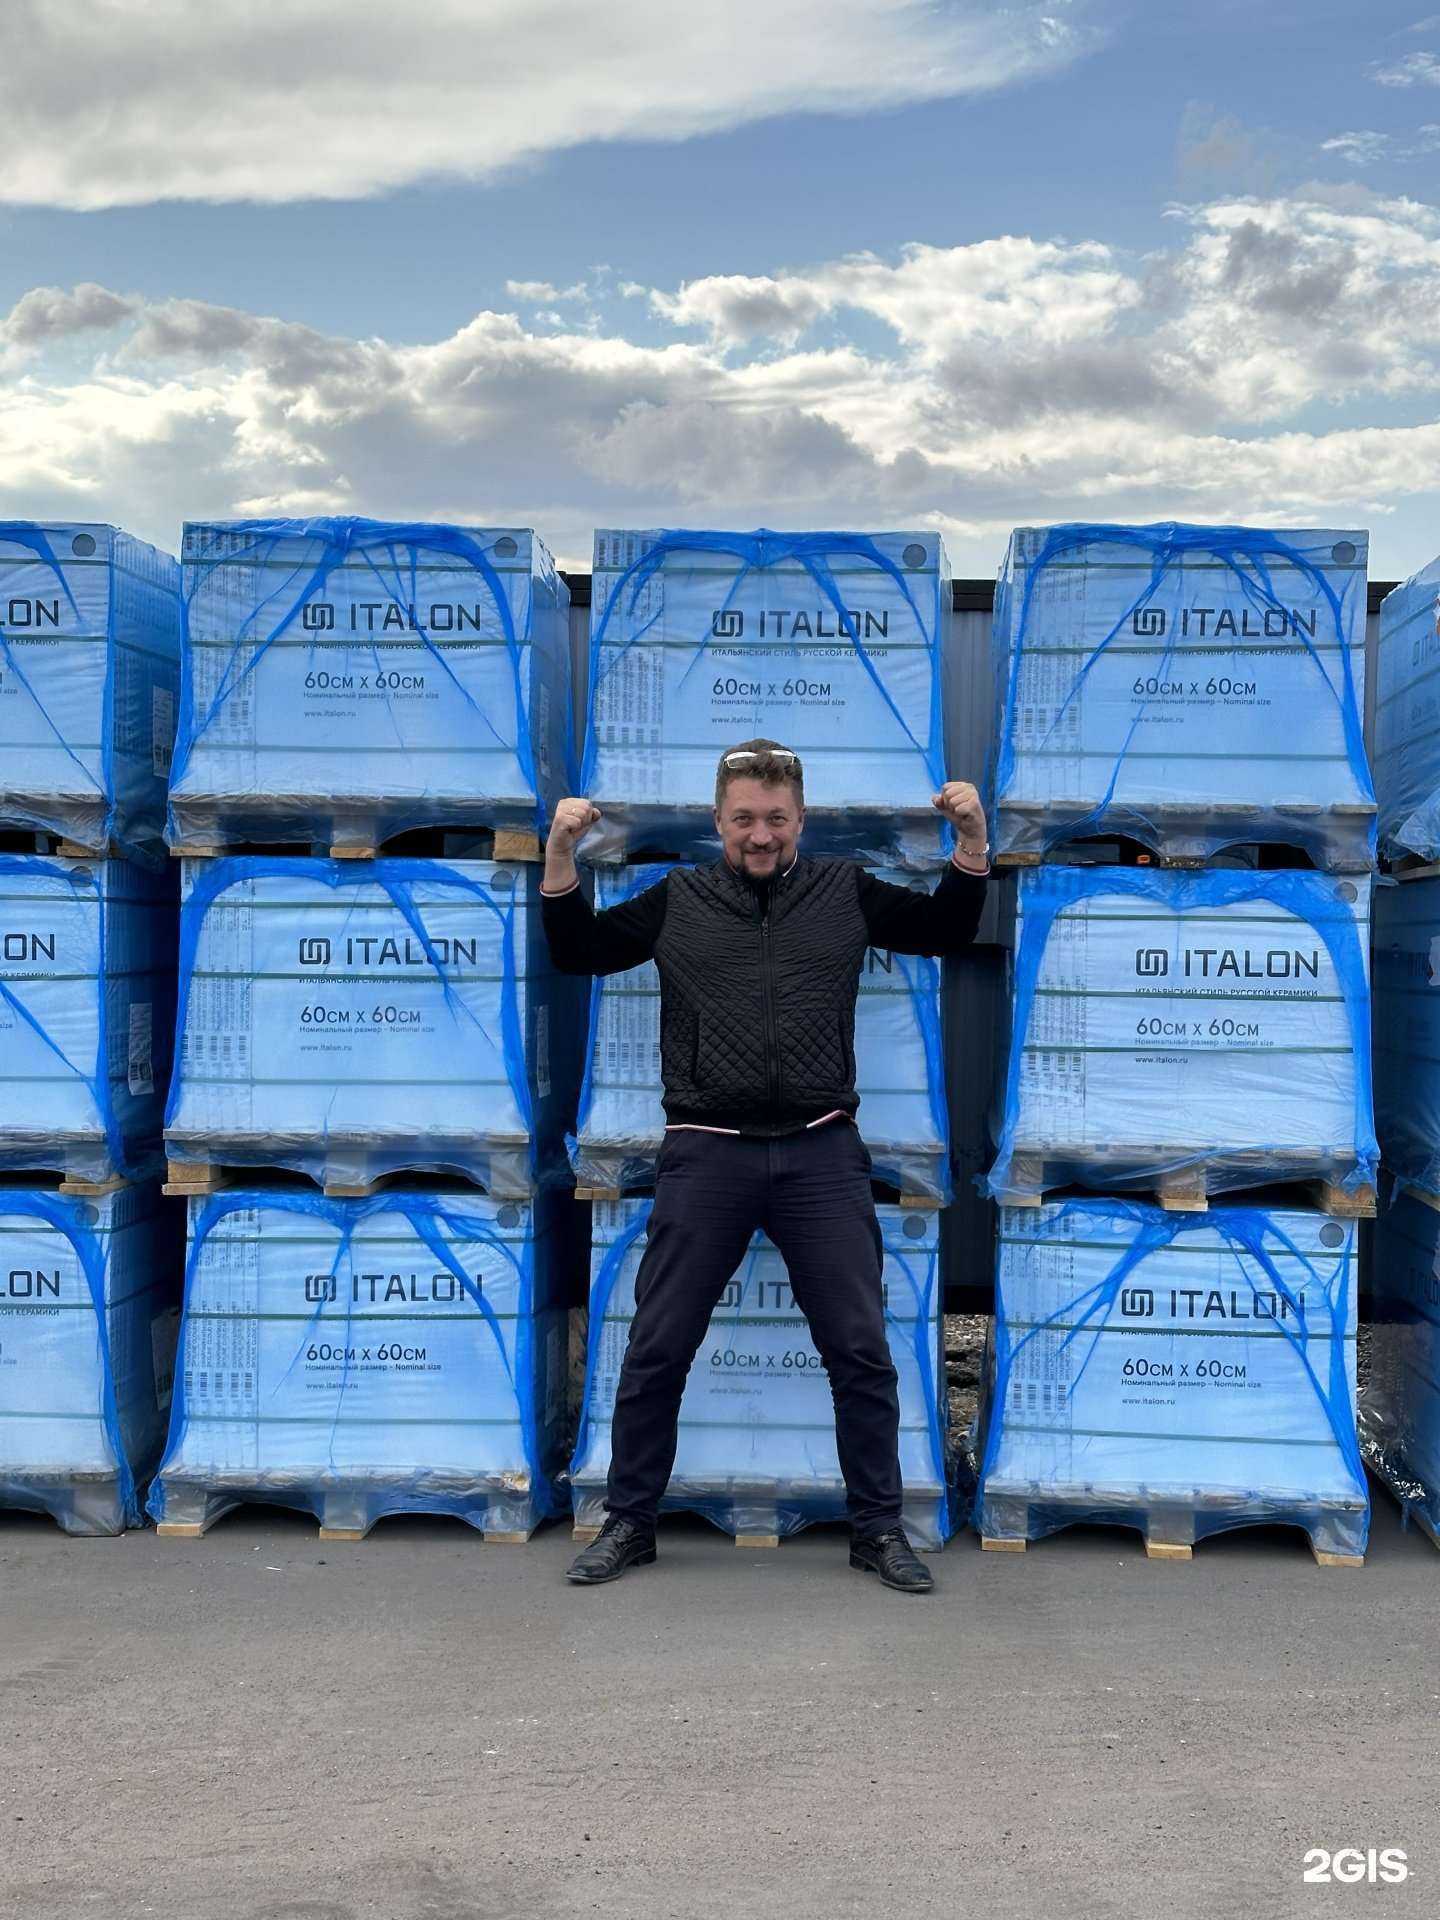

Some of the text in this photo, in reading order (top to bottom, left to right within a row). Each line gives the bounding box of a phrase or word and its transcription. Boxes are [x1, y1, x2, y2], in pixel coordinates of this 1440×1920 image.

[351, 603, 481, 631] ITALON
[759, 610, 888, 638] ITALON
[1182, 608, 1316, 637] ITALON
[711, 648, 771, 657] ИТАЛЬЯНСКИЙ
[803, 649, 842, 657] РУССКОЙ
[346, 938, 477, 965] ITALON
[1184, 949, 1319, 978] ITALON
[1135, 1056, 1188, 1064] www.italon.ru
[1170, 1290, 1305, 1319] ITALON
[1121, 1379, 1175, 1388] Номинальный
[1177, 1380, 1206, 1390] размер
[1213, 1379, 1245, 1388] Nominal
